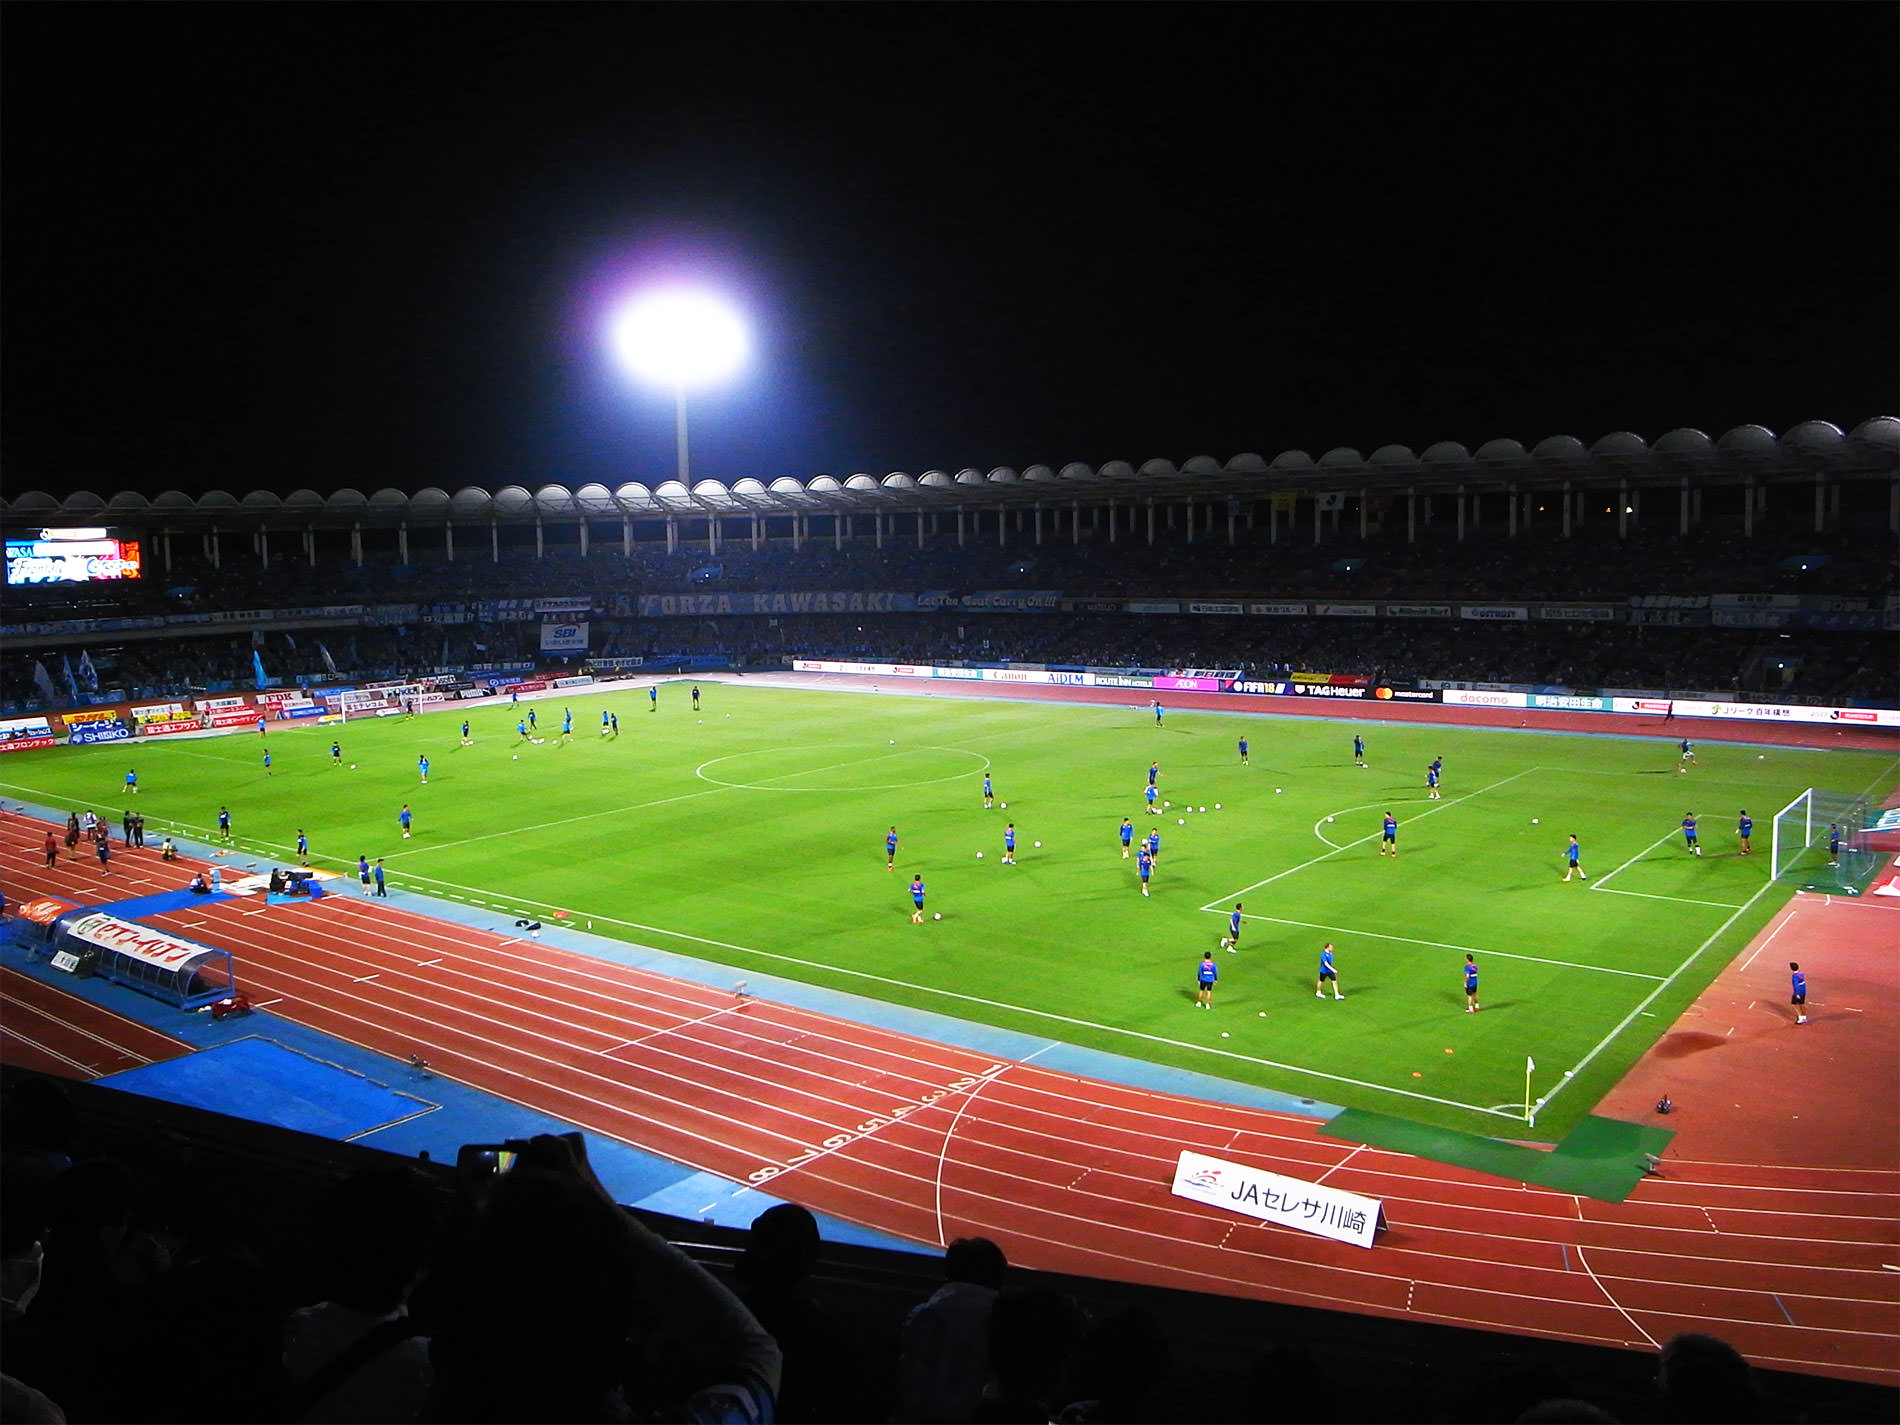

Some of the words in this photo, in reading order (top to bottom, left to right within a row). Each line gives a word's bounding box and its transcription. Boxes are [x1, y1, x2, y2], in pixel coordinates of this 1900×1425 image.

[640, 594, 733, 616] FORZA
[752, 592, 894, 614] KAWASAKI
[553, 628, 577, 639] SBI
[993, 671, 1027, 681] Canon
[1095, 677, 1118, 686] ROUTE
[267, 693, 293, 702] FDK
[461, 688, 483, 699] PUMA
[1394, 691, 1433, 699] mastercard
[1460, 693, 1508, 705] docomo
[1535, 695, 1603, 709] 明治安田生命
[1723, 706, 1790, 717] Jリーグ百年構想
[982, 1064, 1002, 1076] 1
[948, 1077, 976, 1089] 2
[921, 1090, 947, 1102] 3
[892, 1105, 917, 1117] 4
[857, 1118, 887, 1132] 5
[823, 1134, 851, 1149] 6
[787, 1149, 820, 1163] 7
[748, 1167, 779, 1181] 8
[1231, 1181, 1368, 1235] JAセレサ川崎
